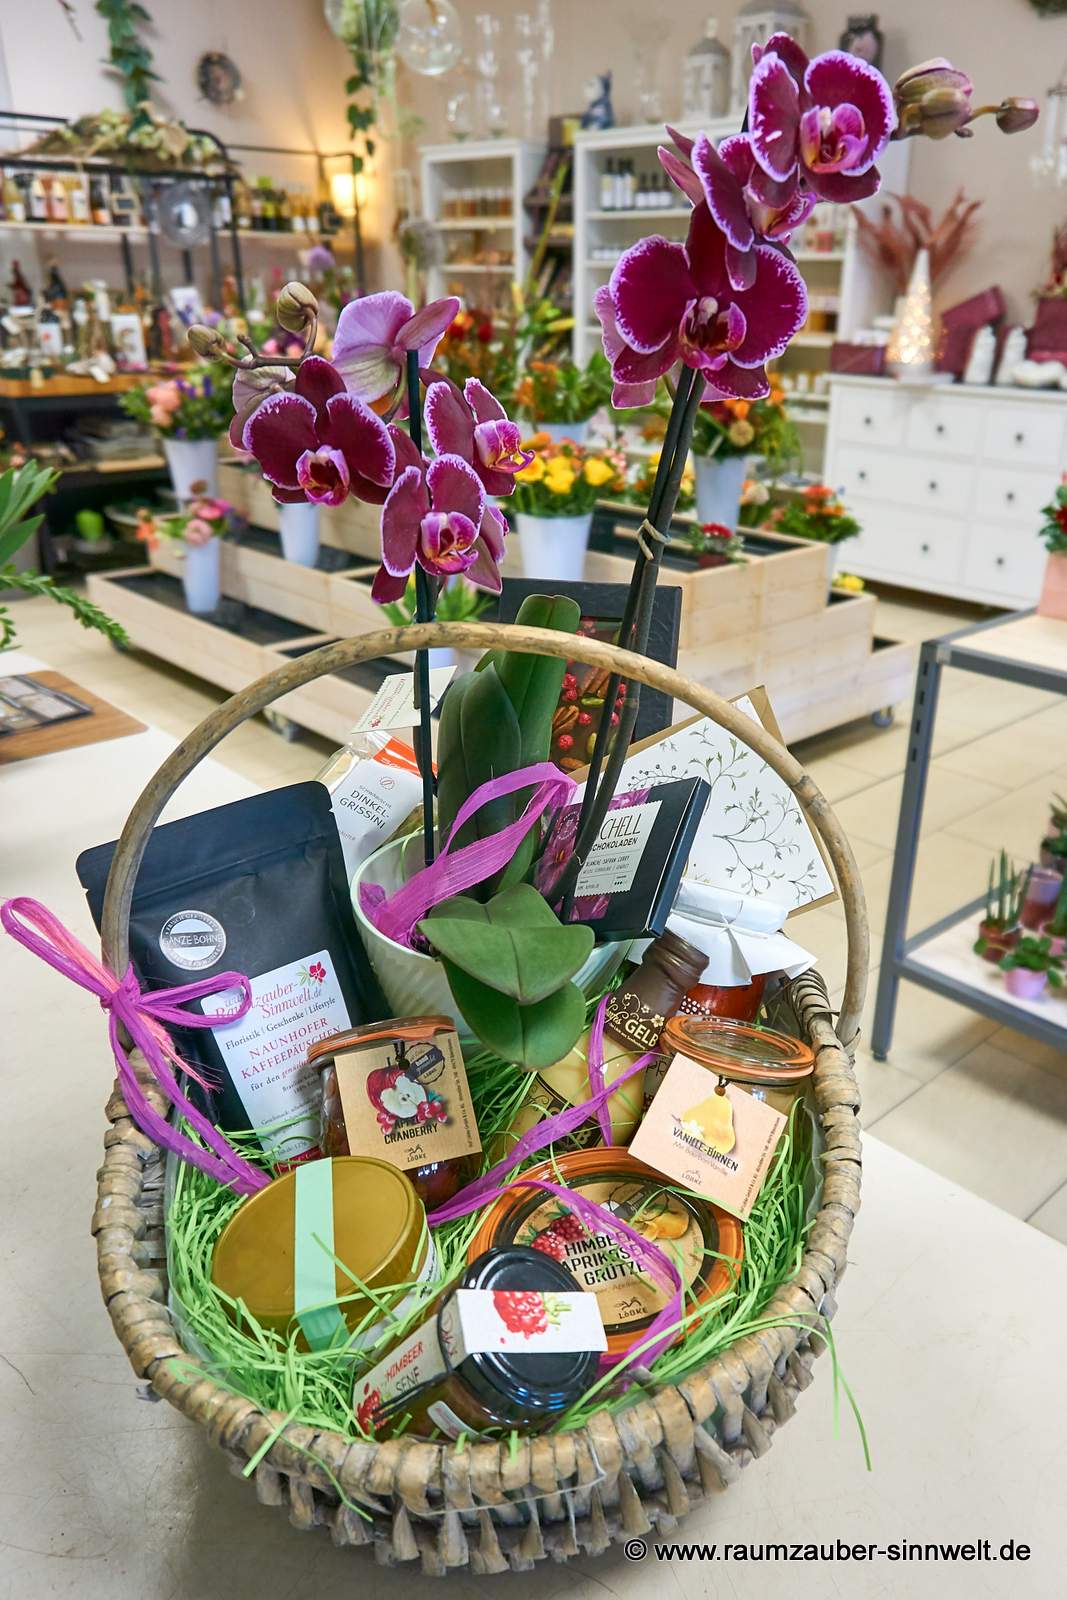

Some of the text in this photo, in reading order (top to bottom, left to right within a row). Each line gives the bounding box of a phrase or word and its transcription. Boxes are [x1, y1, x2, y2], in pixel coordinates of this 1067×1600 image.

[339, 797, 386, 829] GRISSINI
[350, 790, 390, 818] DINKEL-
[600, 813, 642, 841] CHELL
[592, 837, 639, 852] CHOKOLADEN
[161, 933, 224, 946] GANZE BOHNE
[225, 996, 336, 1050] Floristik Geschenke Lifestyle
[625, 1019, 659, 1047] GELB
[249, 1017, 329, 1060] NAUNHOFER
[250, 1081, 264, 1092] für
[266, 1074, 281, 1085] den
[384, 1124, 439, 1145] CRANBERRY
[673, 1127, 739, 1171] VANILLE-BIRNEN
[385, 1341, 424, 1381] HIMBEER
